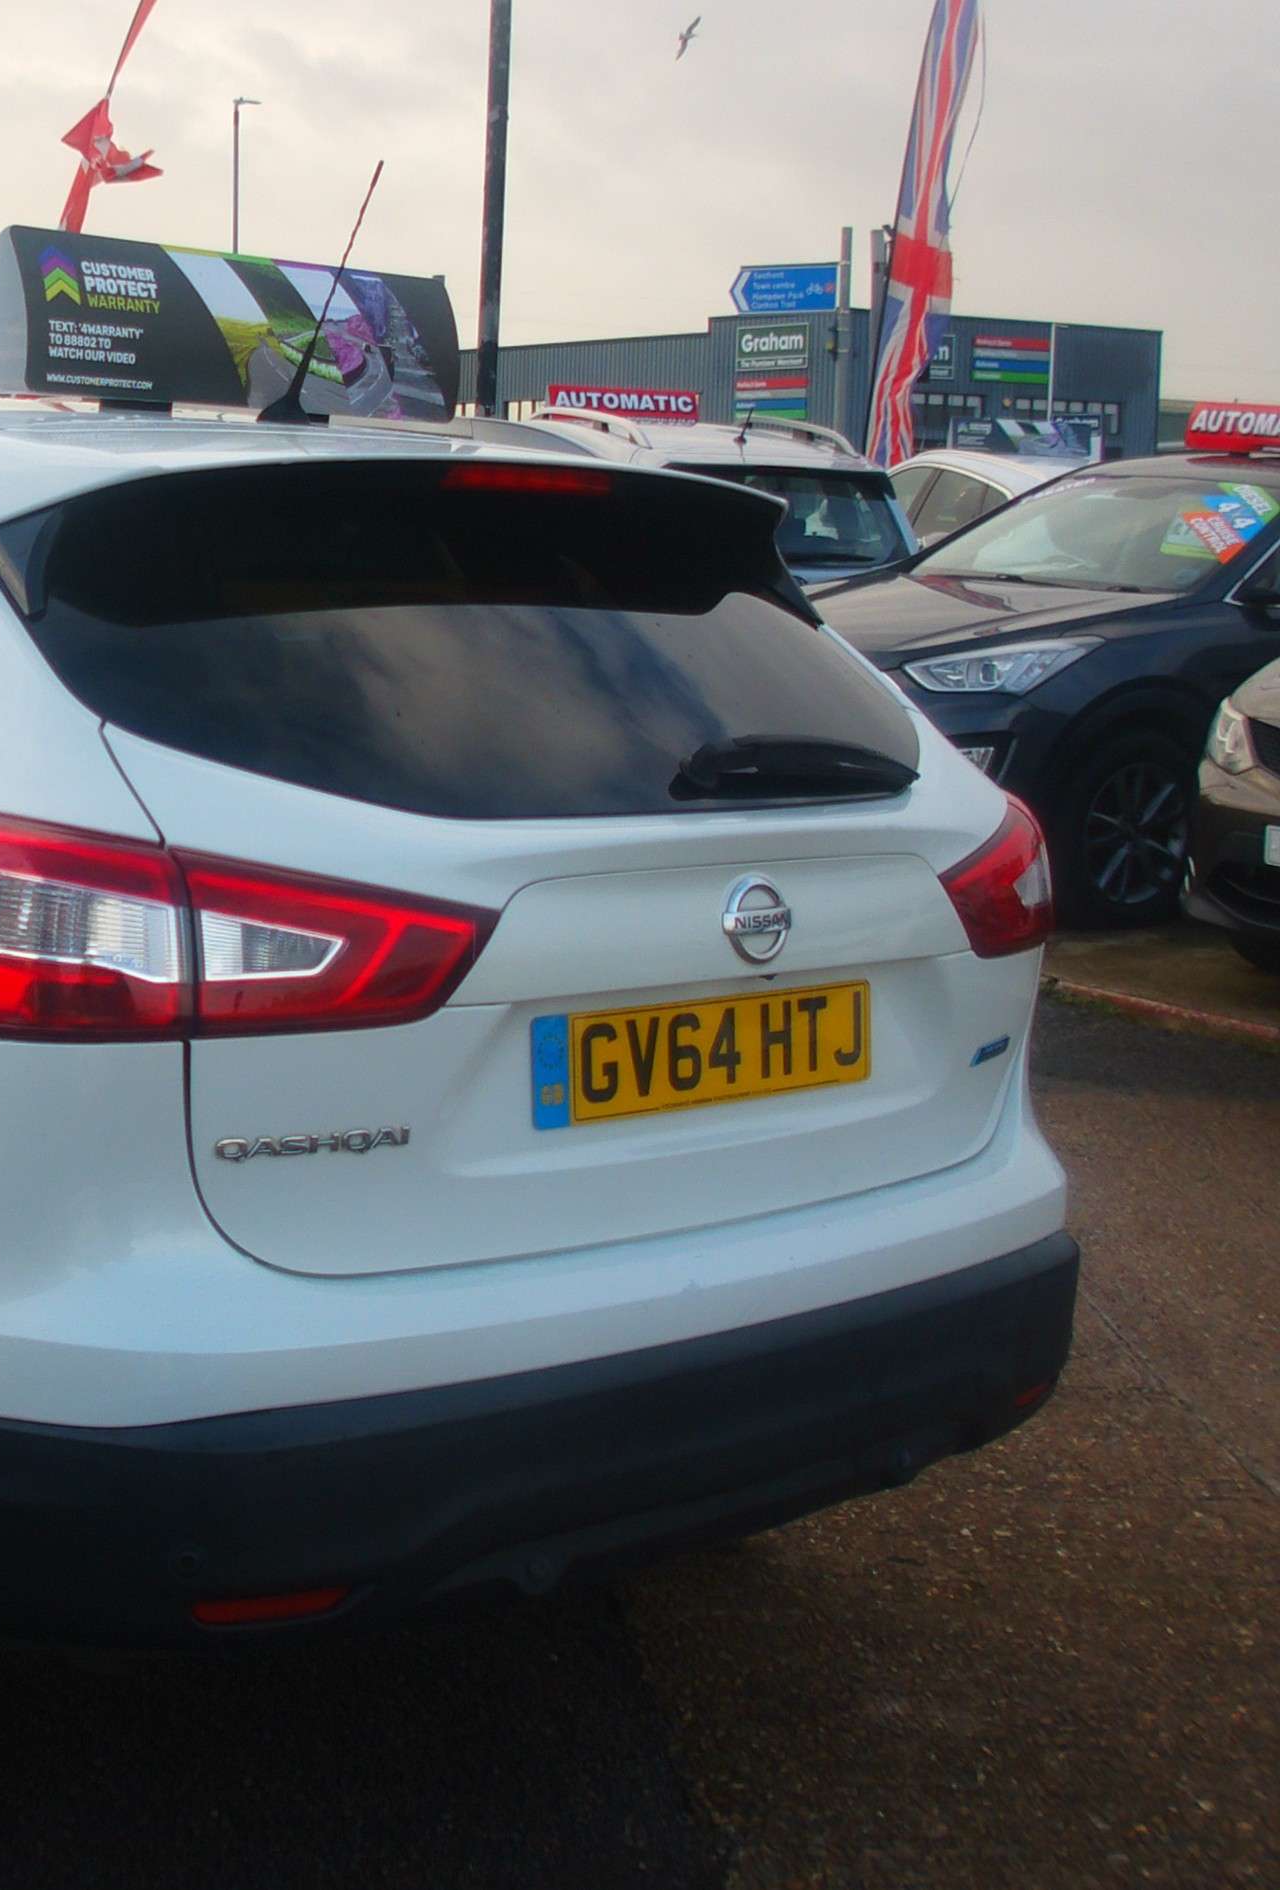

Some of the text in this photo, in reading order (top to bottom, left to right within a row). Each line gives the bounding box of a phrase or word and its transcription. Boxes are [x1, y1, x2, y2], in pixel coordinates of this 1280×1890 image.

[80, 261, 155, 282] CUSTOMER
[84, 276, 157, 299] PROTECT
[87, 294, 160, 314] WARRANTY
[48, 320, 78, 334] TEXT:
[49, 333, 63, 344] TO
[98, 338, 111, 350] TO
[741, 333, 804, 352] Graham
[48, 346, 136, 365] WATCH OUR VIDEO
[46, 373, 153, 390] WWW.CUSTOMERPROTECT.COM
[556, 391, 694, 412] AUTOMATIC
[734, 912, 790, 930] NISSAN
[581, 991, 862, 1105] GV64 HTJ
[541, 1084, 564, 1106] GB
[217, 1126, 412, 1162] QASHQAI
